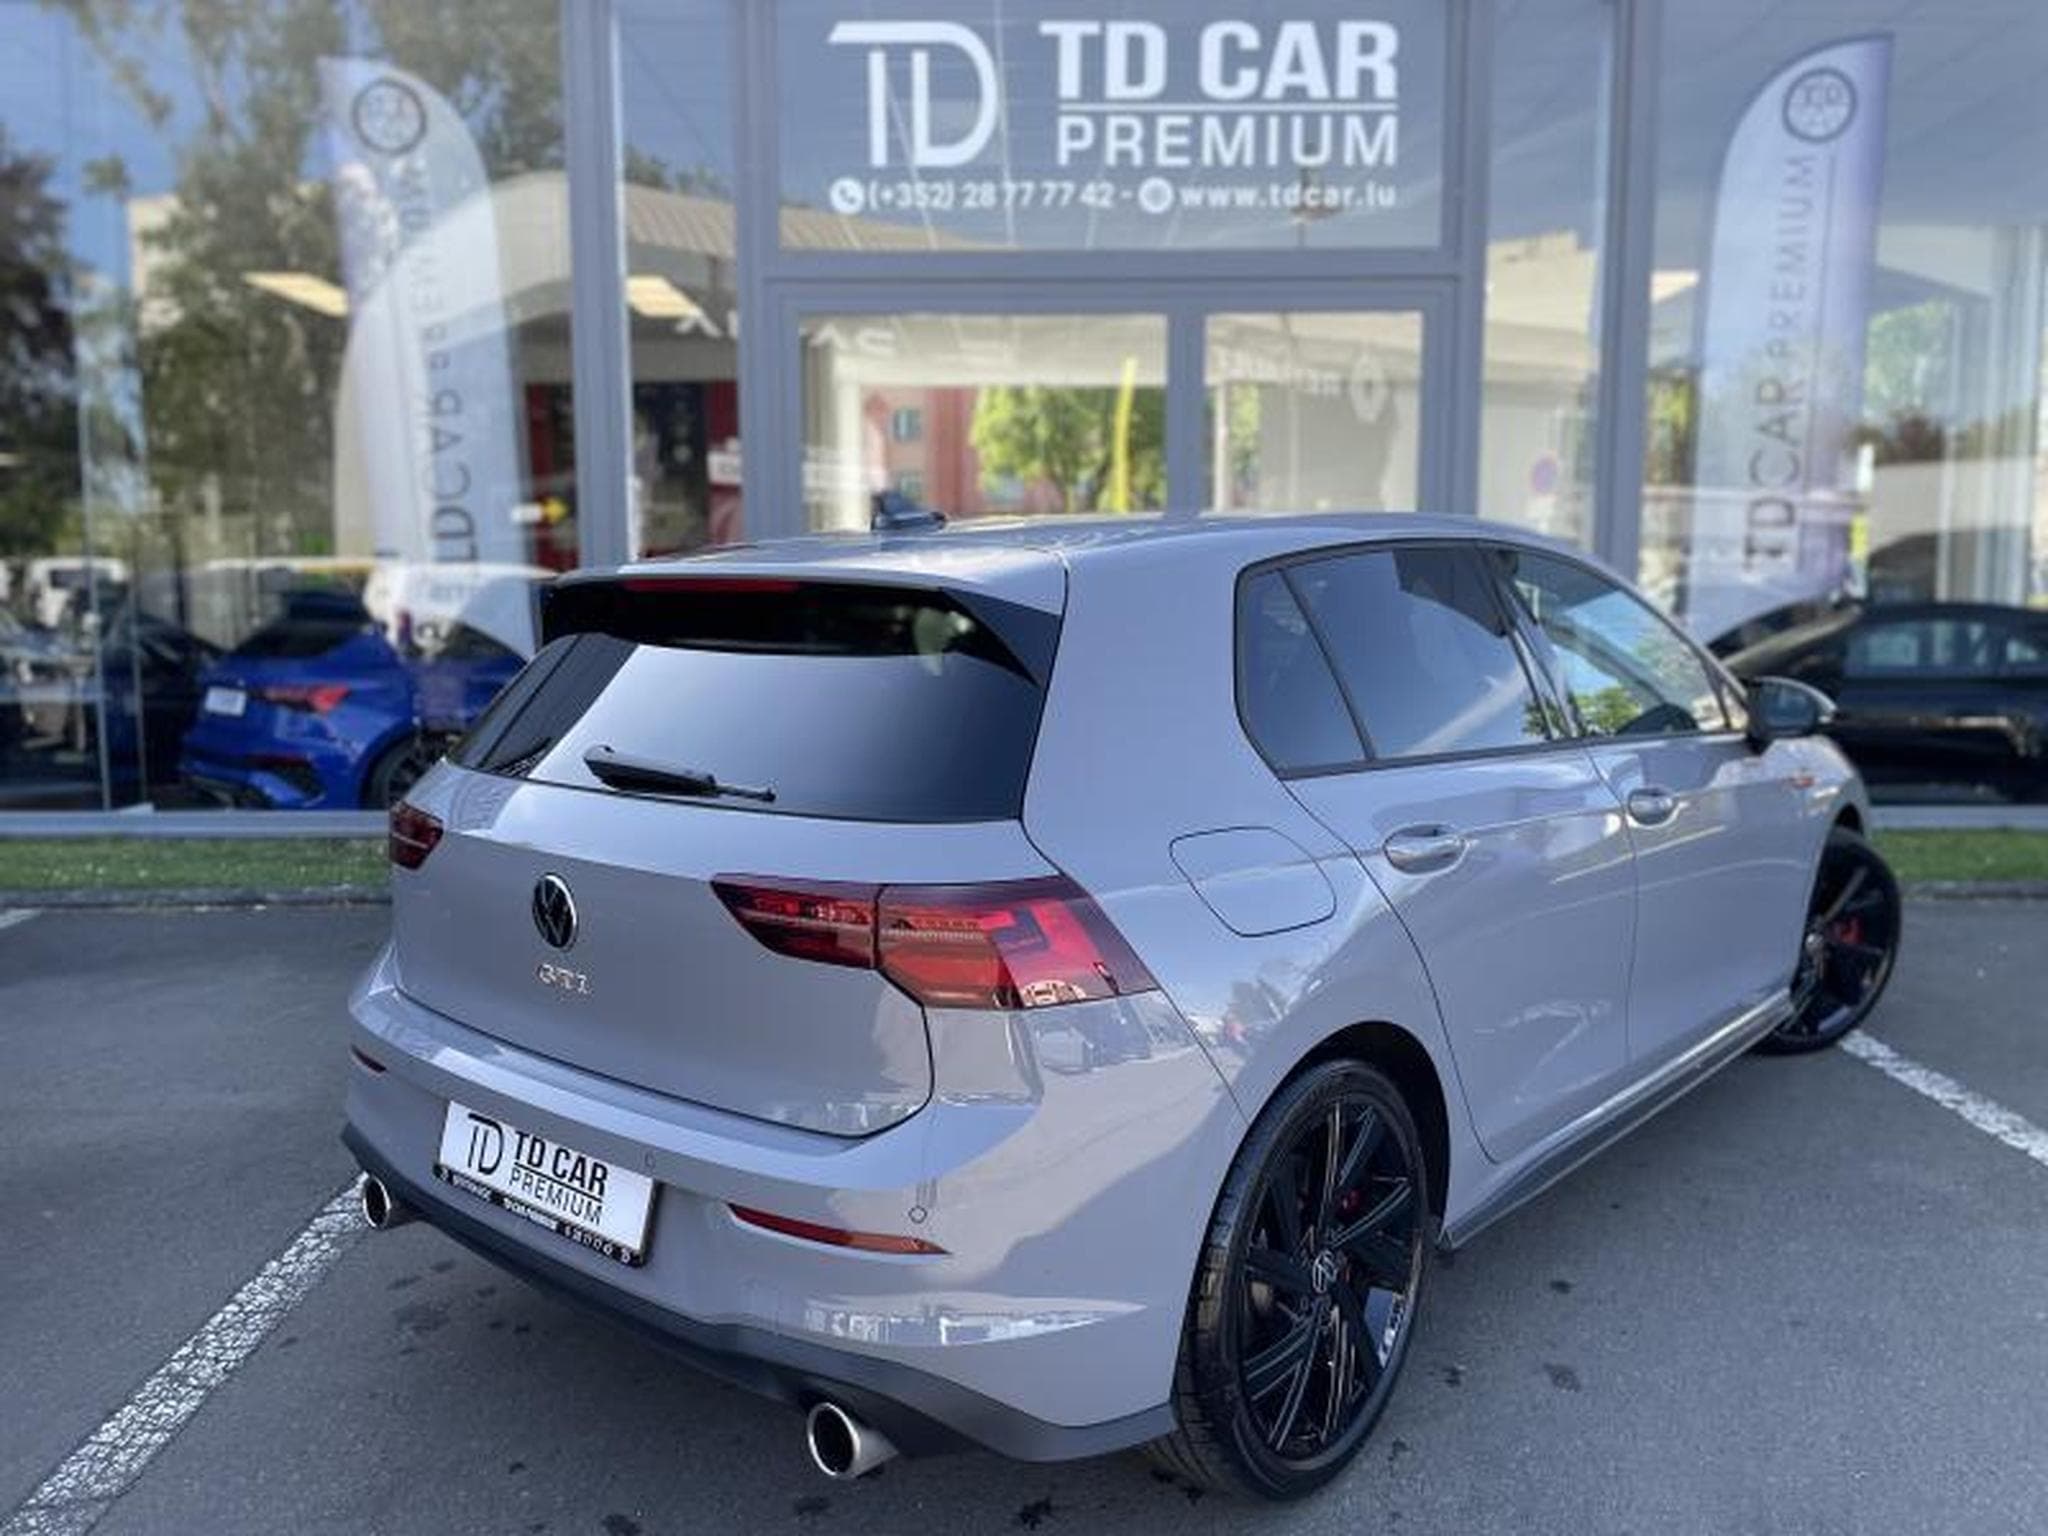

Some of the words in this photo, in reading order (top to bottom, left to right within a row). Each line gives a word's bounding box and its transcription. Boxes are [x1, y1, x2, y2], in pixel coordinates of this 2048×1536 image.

[1040, 20, 1167, 100] TD
[1199, 20, 1398, 100] CAR
[1057, 115, 1397, 167] PREMIUM
[961, 180, 997, 209] 28
[1080, 180, 1116, 208] 42
[1180, 180, 1397, 208] www.tdcar.lu
[513, 1130, 546, 1169] TD
[551, 1148, 609, 1197] CAR
[509, 1167, 604, 1227] PREMIUM
